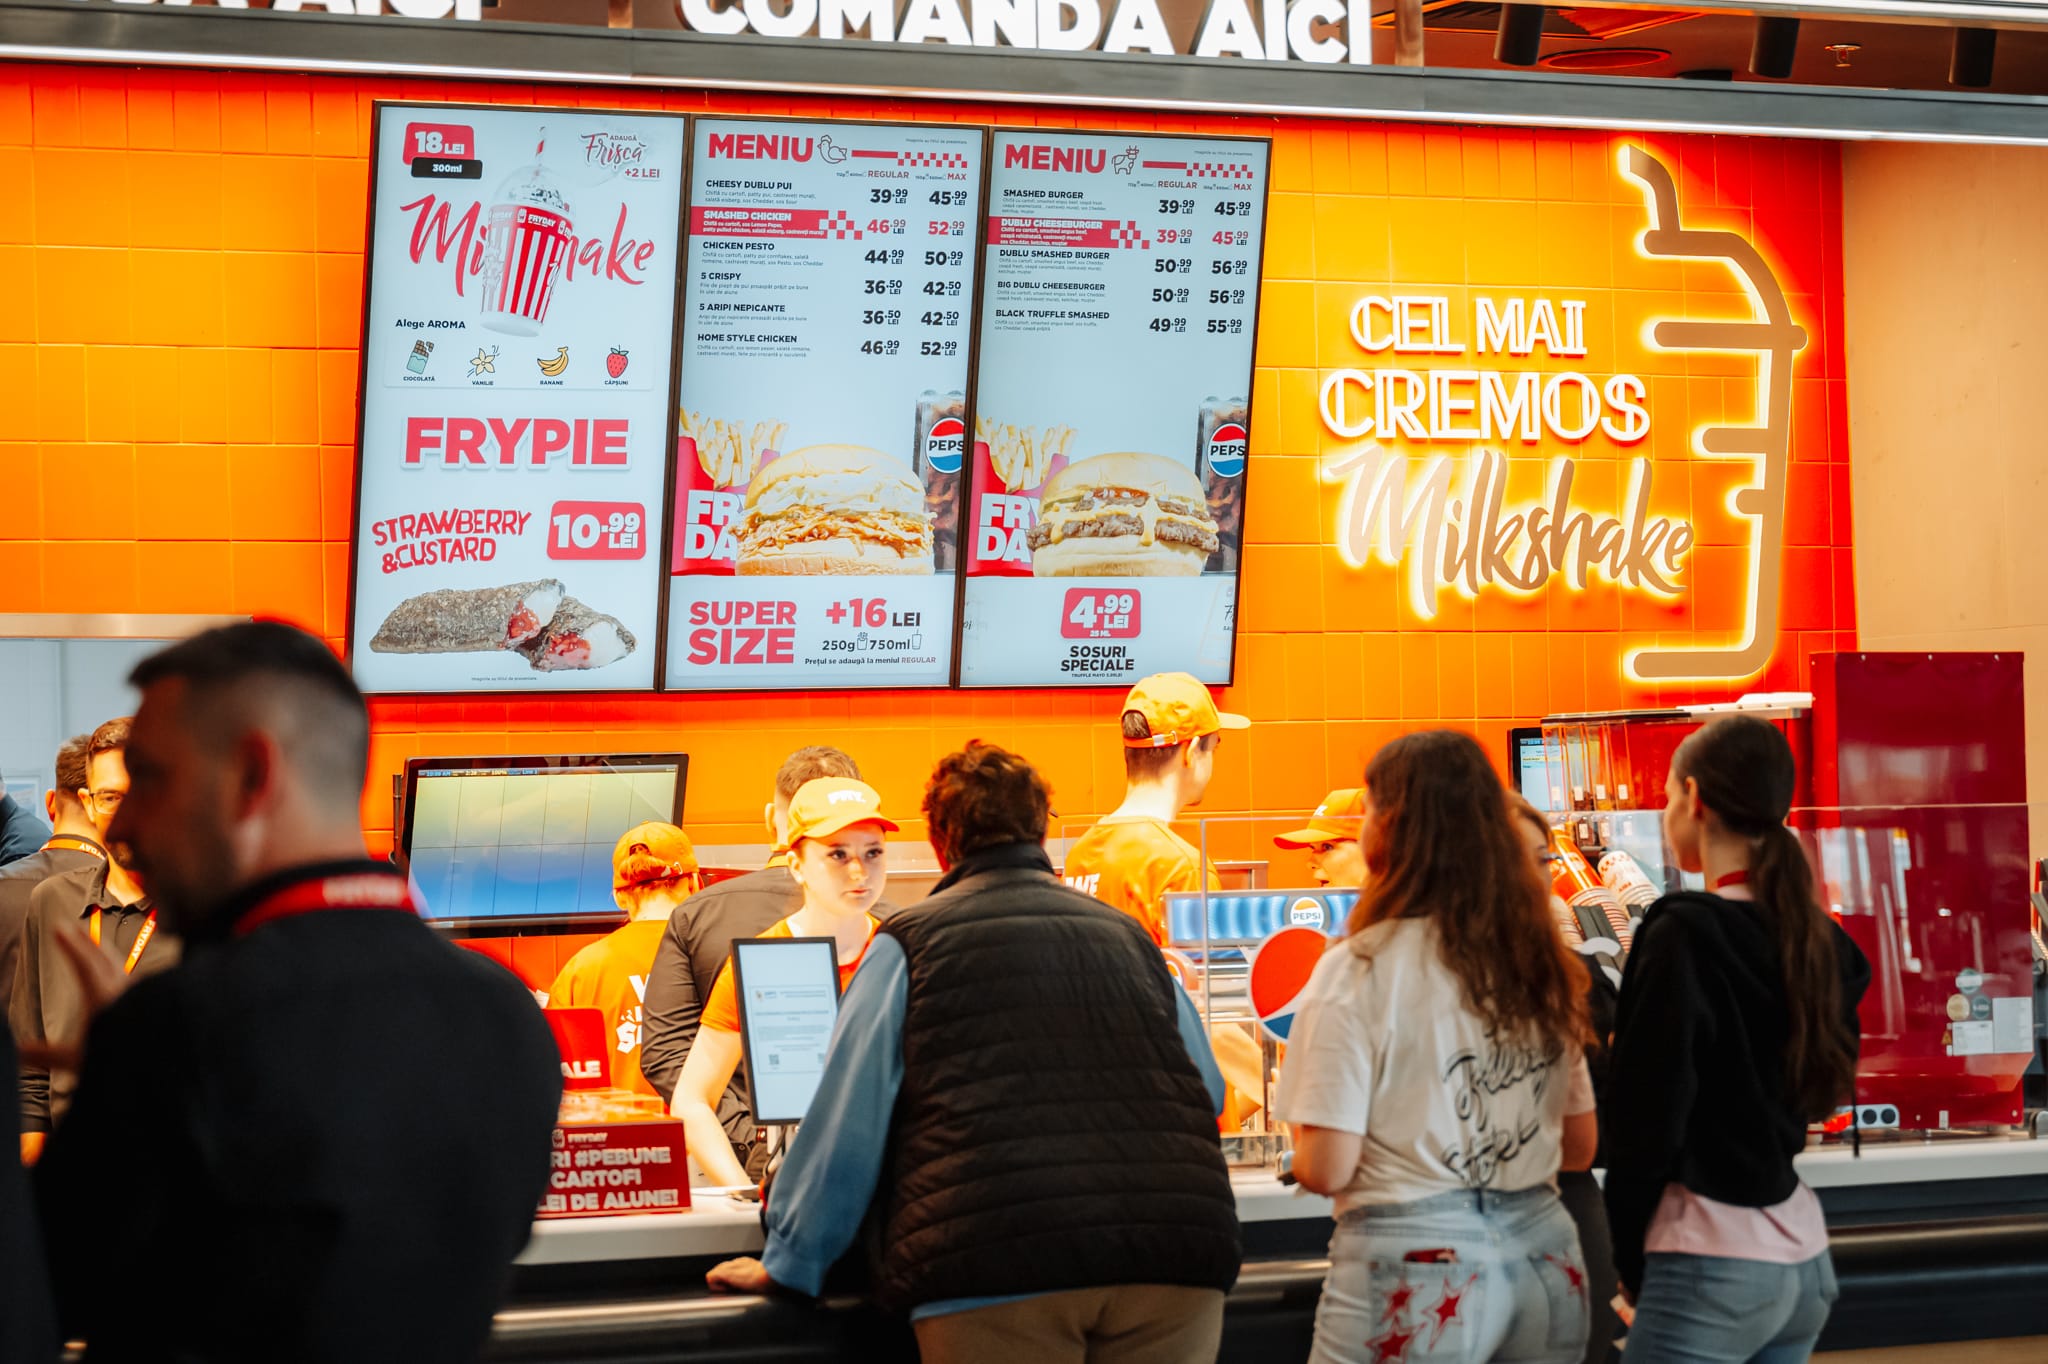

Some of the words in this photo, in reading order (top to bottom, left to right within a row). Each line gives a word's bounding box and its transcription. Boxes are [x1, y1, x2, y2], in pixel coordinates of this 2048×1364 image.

[1195, 0, 1372, 65] AICI
[415, 132, 443, 154] 18
[445, 144, 464, 154] LEI
[708, 133, 813, 162] MENIU
[1005, 144, 1106, 173] MENIU
[432, 164, 462, 173] 300ml
[625, 168, 639, 177] +2
[641, 169, 660, 178] LEI
[868, 171, 909, 179] REGULAR
[744, 181, 775, 189] DUBLU
[1158, 181, 1197, 189] REGULAR
[1234, 183, 1252, 191] MAX
[1048, 191, 1083, 199] BURGER
[704, 211, 749, 219] SMASHED
[750, 212, 791, 221] CHICKEN
[1001, 218, 1031, 227] DUBLU
[1031, 250, 1072, 258] SMASHED
[1028, 310, 1066, 318] TRUFFLE
[396, 319, 424, 330] Alege
[428, 320, 466, 329] AROMA
[1349, 295, 1466, 353] CEL
[1475, 297, 1588, 356] MAI
[1319, 369, 1650, 443] CREMOS
[405, 417, 629, 465] FRYPIE
[371, 508, 532, 546] STRAWBERRY
[1327, 444, 1695, 618] Milkshake
[609, 533, 638, 548] LEI
[382, 538, 496, 574] &CUSTARD
[688, 601, 797, 625] SUPER
[826, 598, 887, 628] +16
[892, 612, 921, 627] LEI
[1104, 614, 1129, 629] LEI
[687, 628, 796, 665] SIZE
[822, 640, 855, 652] 250g
[869, 638, 910, 650] 750ml
[1070, 646, 1126, 658] SOSURI
[838, 656, 865, 667] adaugă
[875, 656, 900, 664] meniul
[1060, 659, 1134, 672] SPECIALE
[1293, 912, 1321, 920] PEPSI
[575, 1147, 672, 1167] #PEBUNE
[550, 1168, 642, 1189] CARTOFI
[570, 1193, 599, 1211] DE
[604, 1189, 679, 1210] ALUNE!
